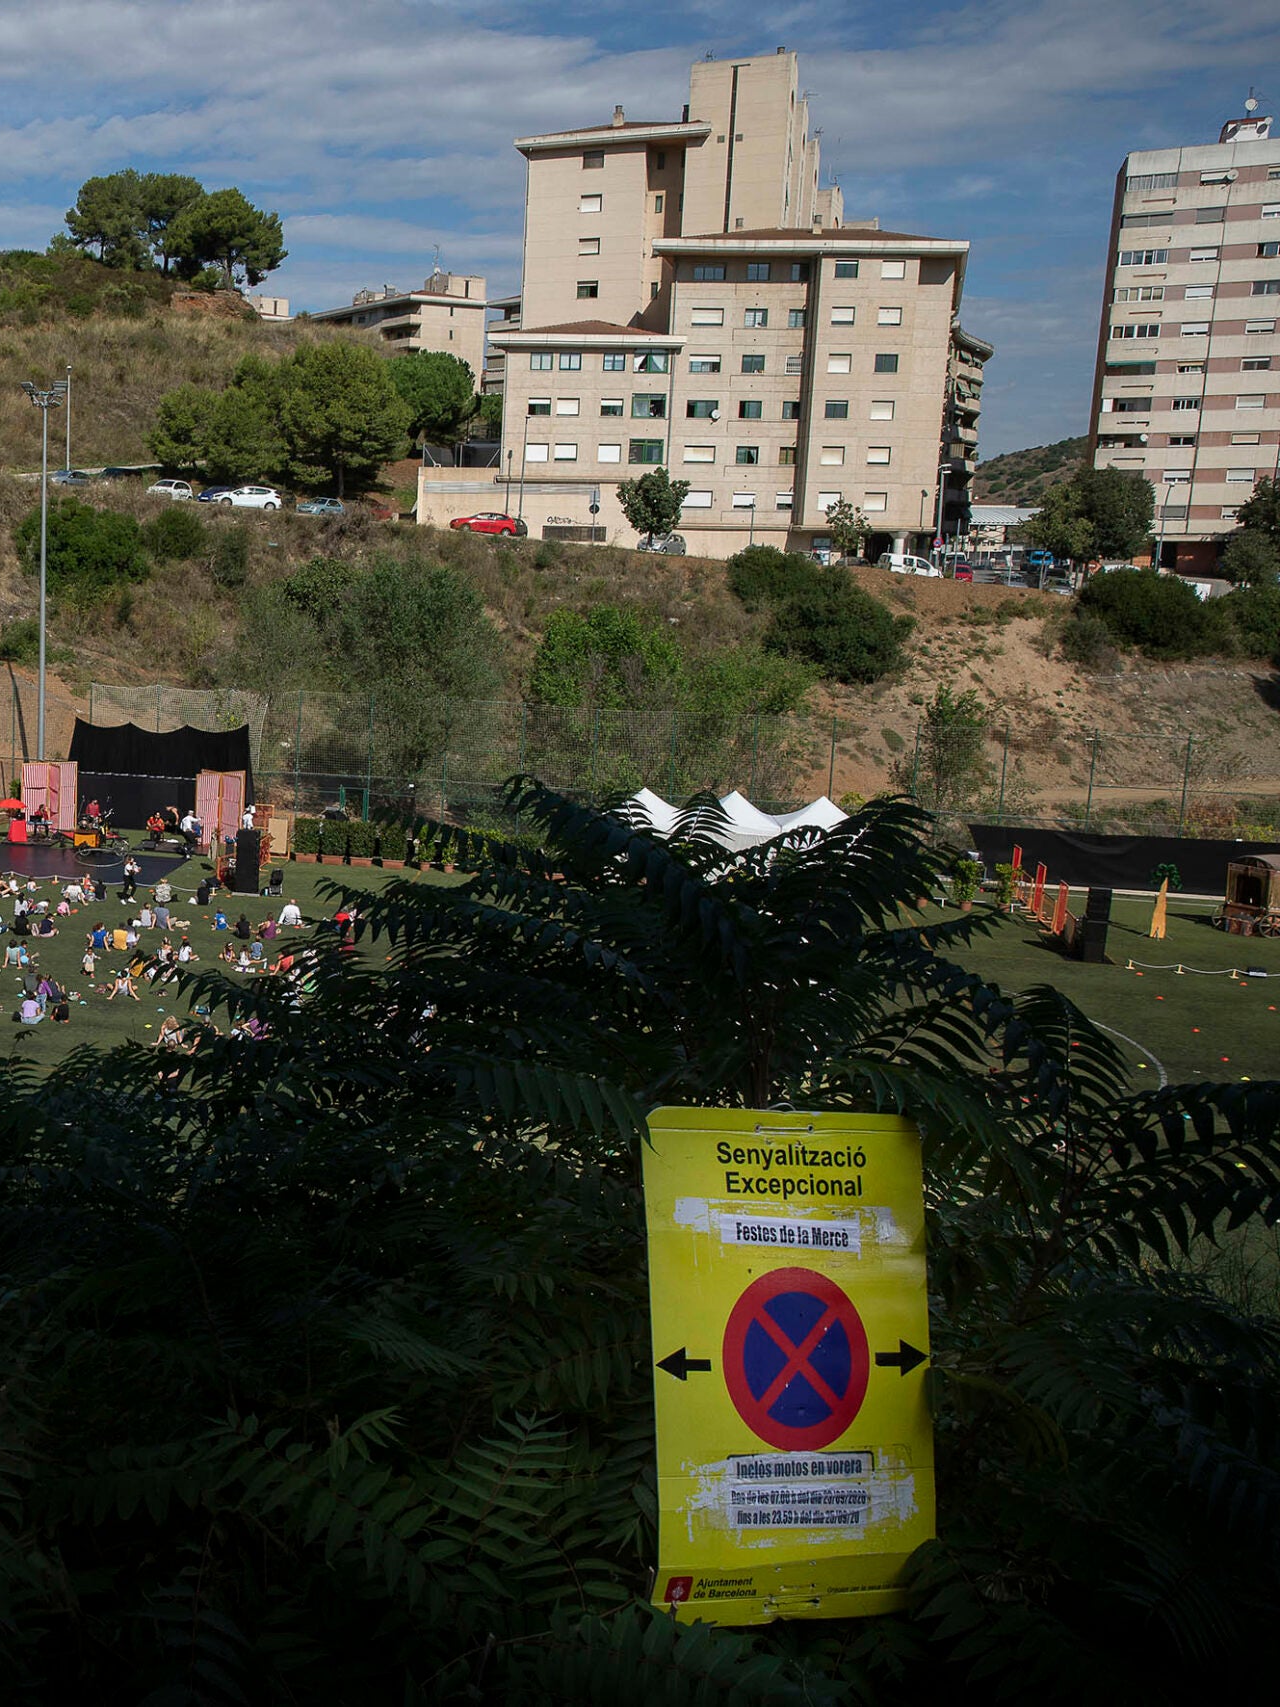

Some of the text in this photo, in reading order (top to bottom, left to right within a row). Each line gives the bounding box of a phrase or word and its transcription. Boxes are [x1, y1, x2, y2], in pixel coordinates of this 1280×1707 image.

[716, 1141, 866, 1171] Senyalització
[725, 1171, 863, 1200] Excepcional
[736, 1222, 849, 1248] Festes de la Mercè
[736, 1459, 862, 1479] Inclòs motos en vorera
[737, 1510, 752, 1524] fins
[753, 1512, 758, 1524] a
[759, 1510, 771, 1524] les
[771, 1510, 793, 1524] 23.59
[693, 1588, 757, 1599] de Barcelona
[696, 1578, 753, 1589] Ajuntament
